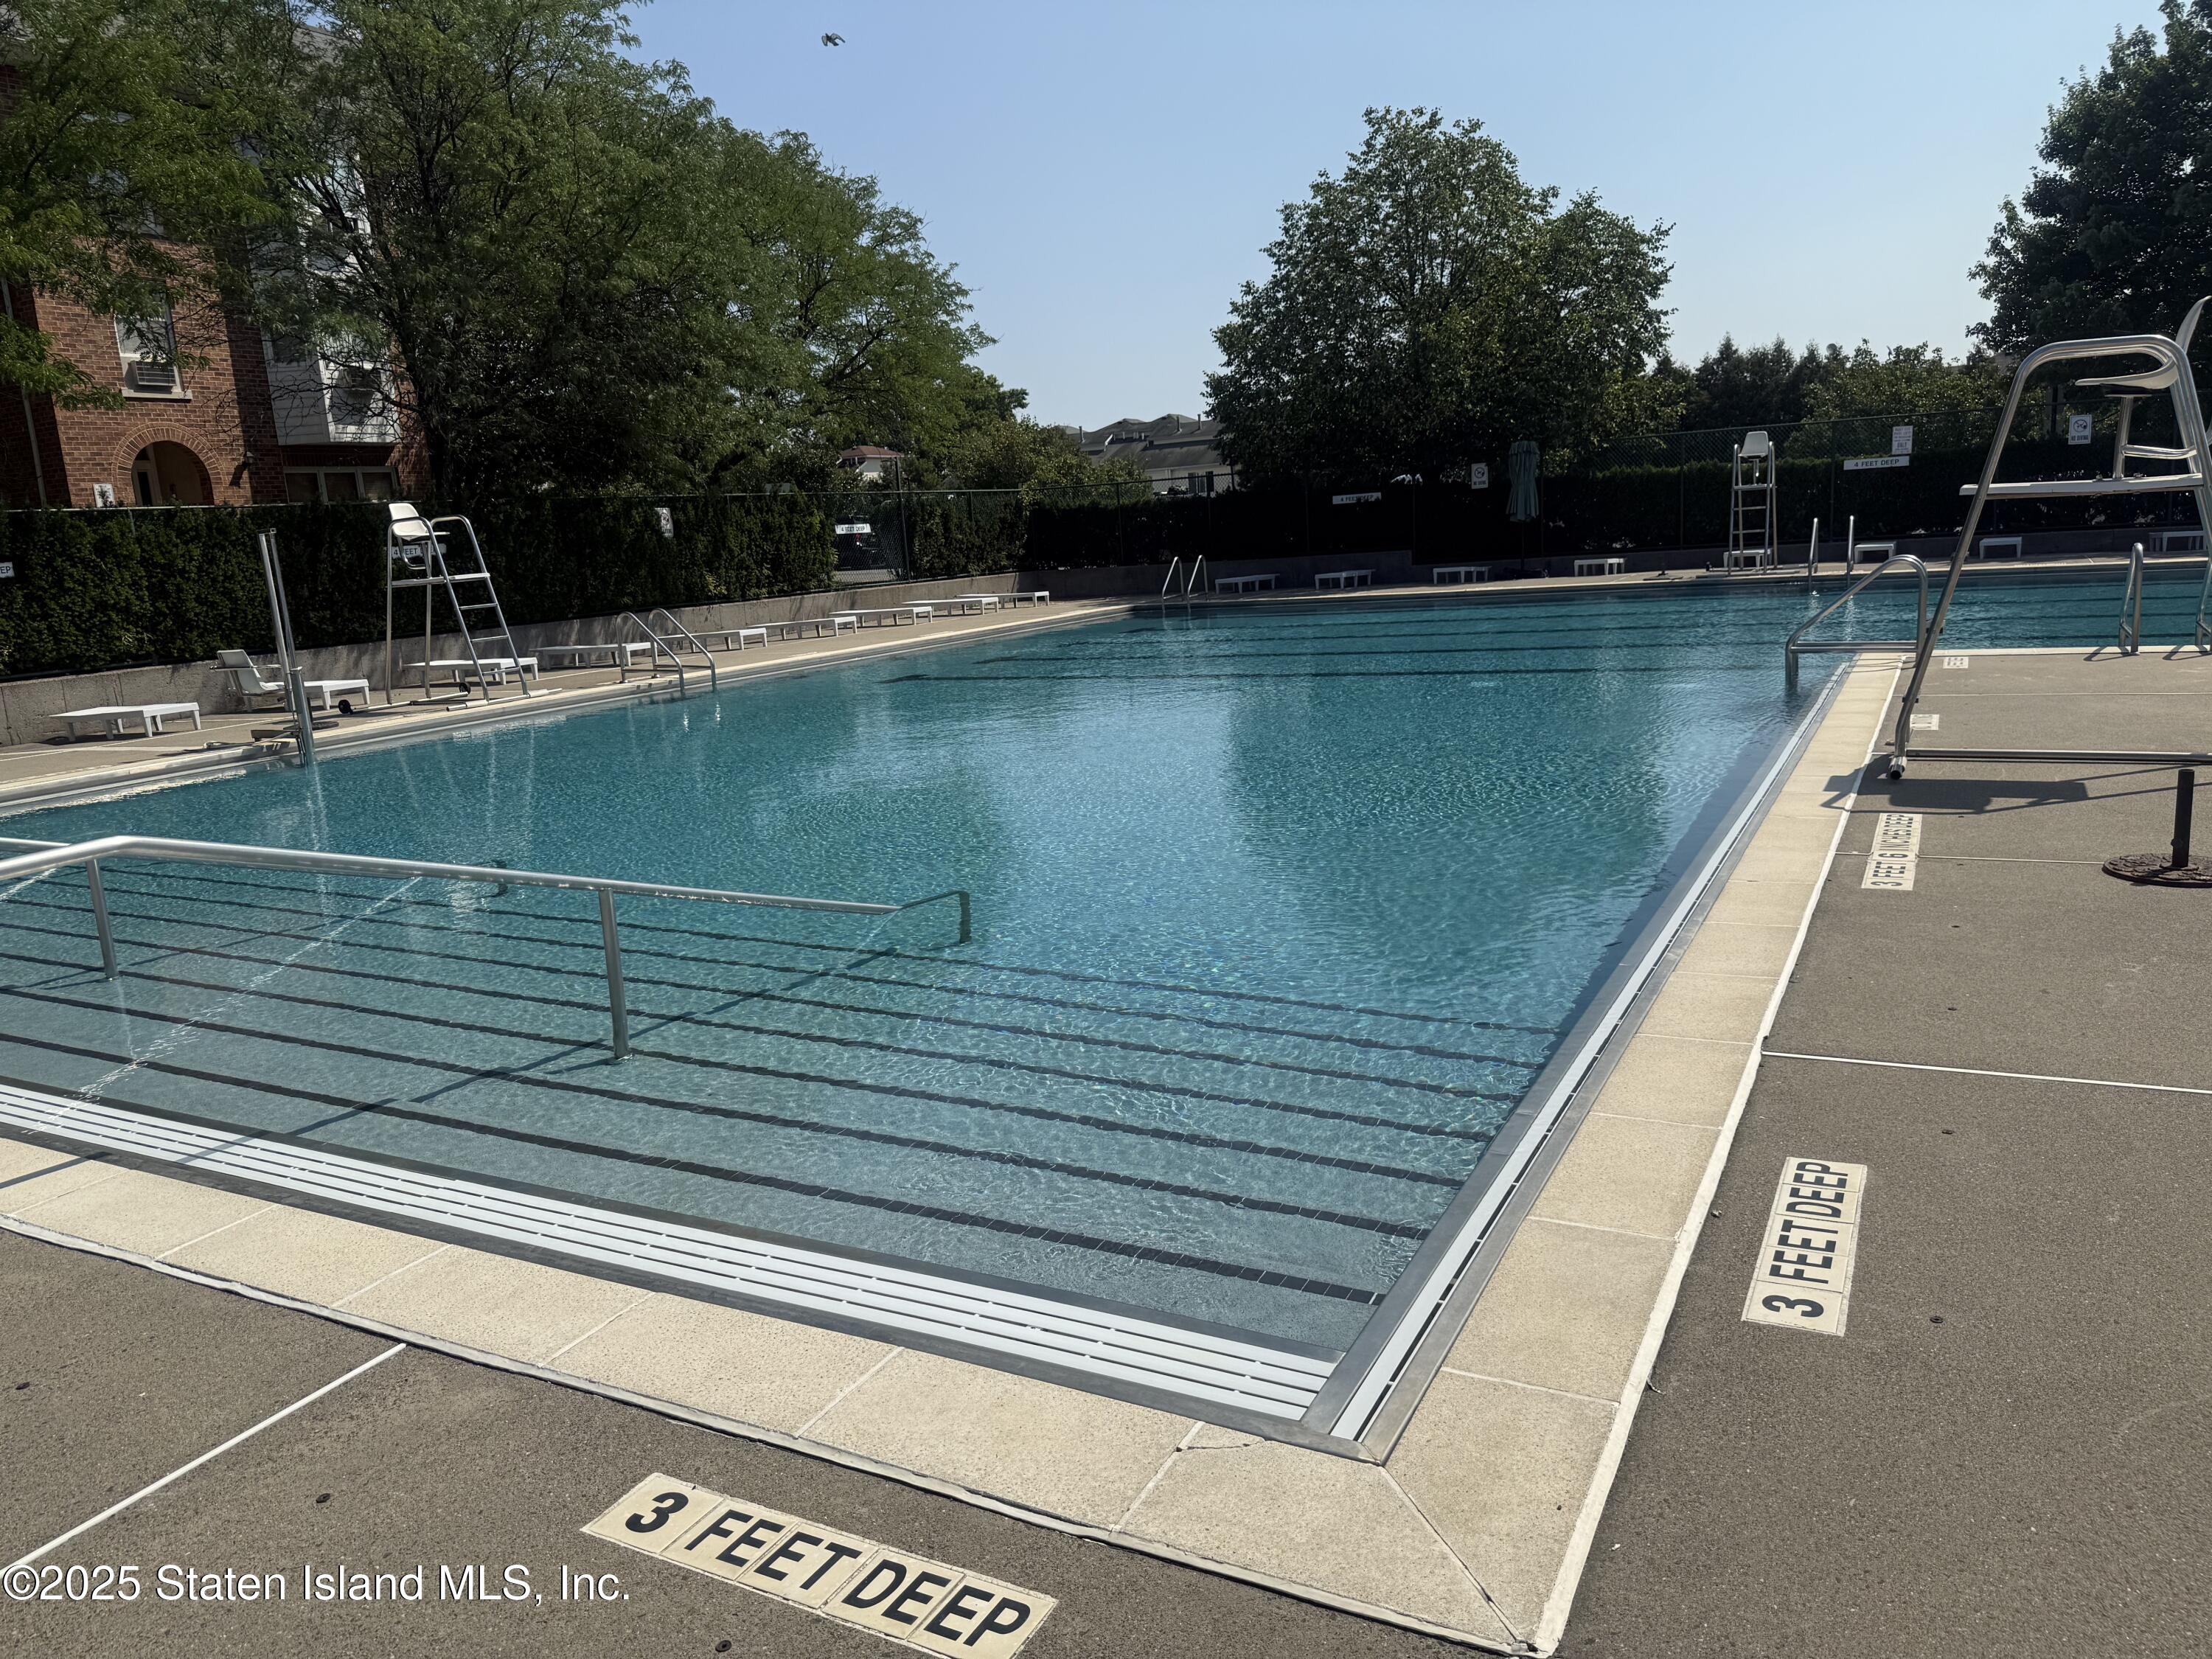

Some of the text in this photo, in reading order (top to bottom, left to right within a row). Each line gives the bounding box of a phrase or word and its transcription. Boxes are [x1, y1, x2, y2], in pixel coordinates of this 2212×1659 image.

[1884, 814, 1913, 828] DEEP
[1879, 829, 1912, 851] INCHES
[1872, 861, 1907, 878] FEET
[1761, 1161, 1848, 1318] 3 FEET DEEP
[625, 1492, 1031, 1646] 3 FEET DEEP
